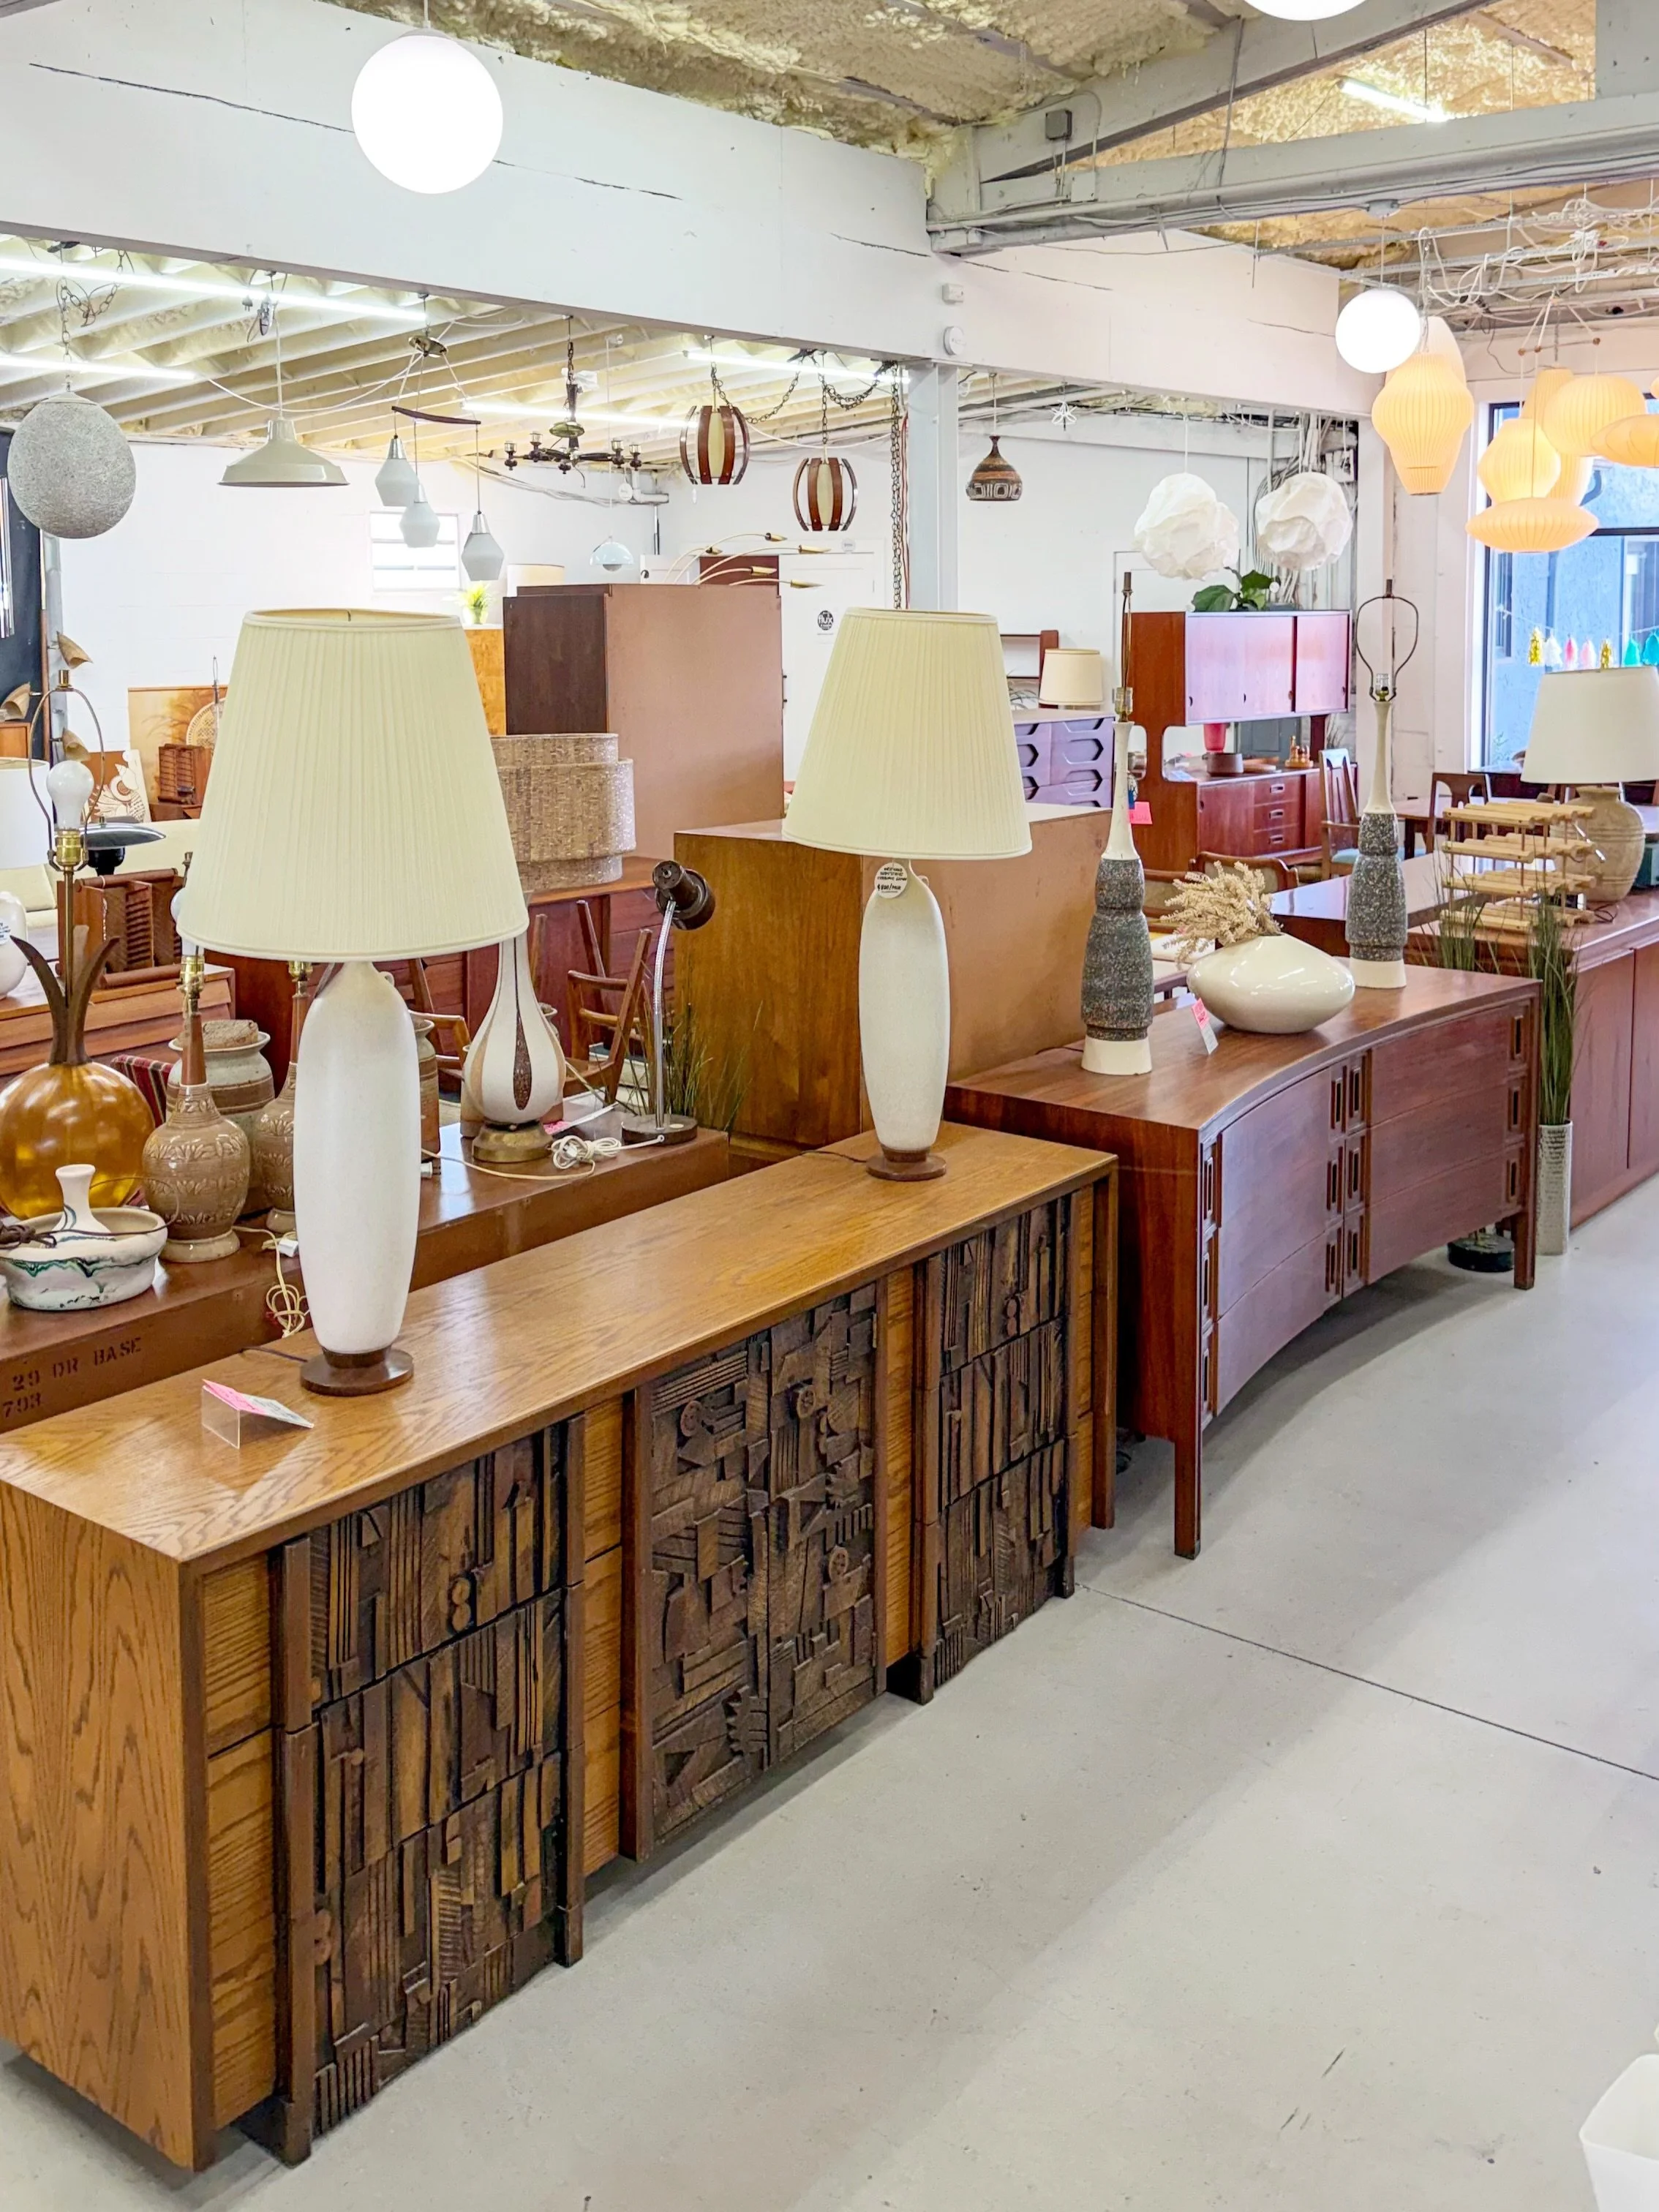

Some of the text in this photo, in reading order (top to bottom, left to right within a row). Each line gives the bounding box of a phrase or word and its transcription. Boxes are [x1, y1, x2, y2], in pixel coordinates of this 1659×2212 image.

[12, 1337, 141, 1391] 29 DR BASE
